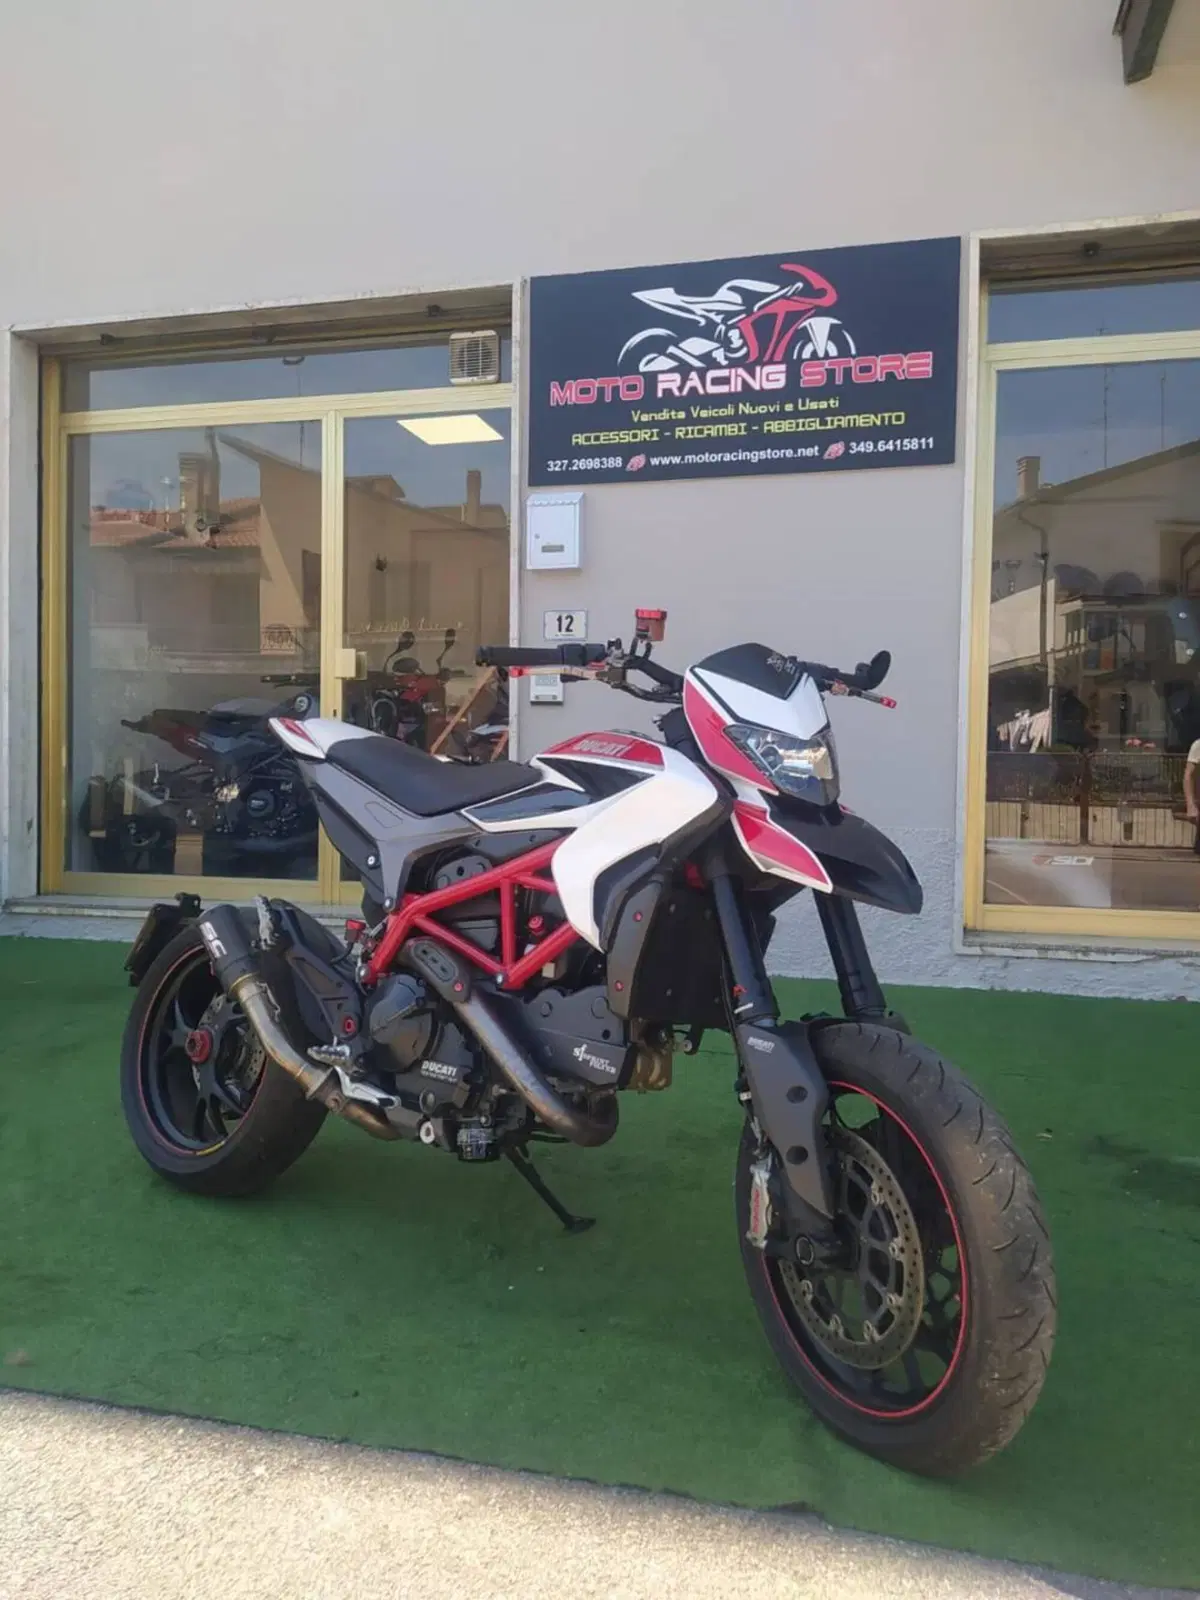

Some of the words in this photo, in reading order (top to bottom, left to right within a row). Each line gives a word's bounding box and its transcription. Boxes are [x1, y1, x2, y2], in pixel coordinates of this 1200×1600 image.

[550, 374, 645, 407] MOTO
[656, 363, 788, 399] RACING
[799, 351, 934, 389] STORE
[630, 408, 687, 423] Vendita
[689, 403, 736, 419] Veicoli
[738, 400, 781, 416] Nuovi
[783, 402, 795, 413] e
[797, 396, 841, 412] Usati
[571, 428, 661, 447] ACCESSORI
[674, 421, 748, 440] RICAMBI
[762, 411, 907, 434] ABBIGLIAMENTO
[546, 456, 623, 473] 327.2698388
[650, 445, 821, 467] www.motoracingstore.net
[848, 436, 935, 455] 349.6415811
[556, 614, 574, 633] 12
[421, 1060, 458, 1077] DUCATI
